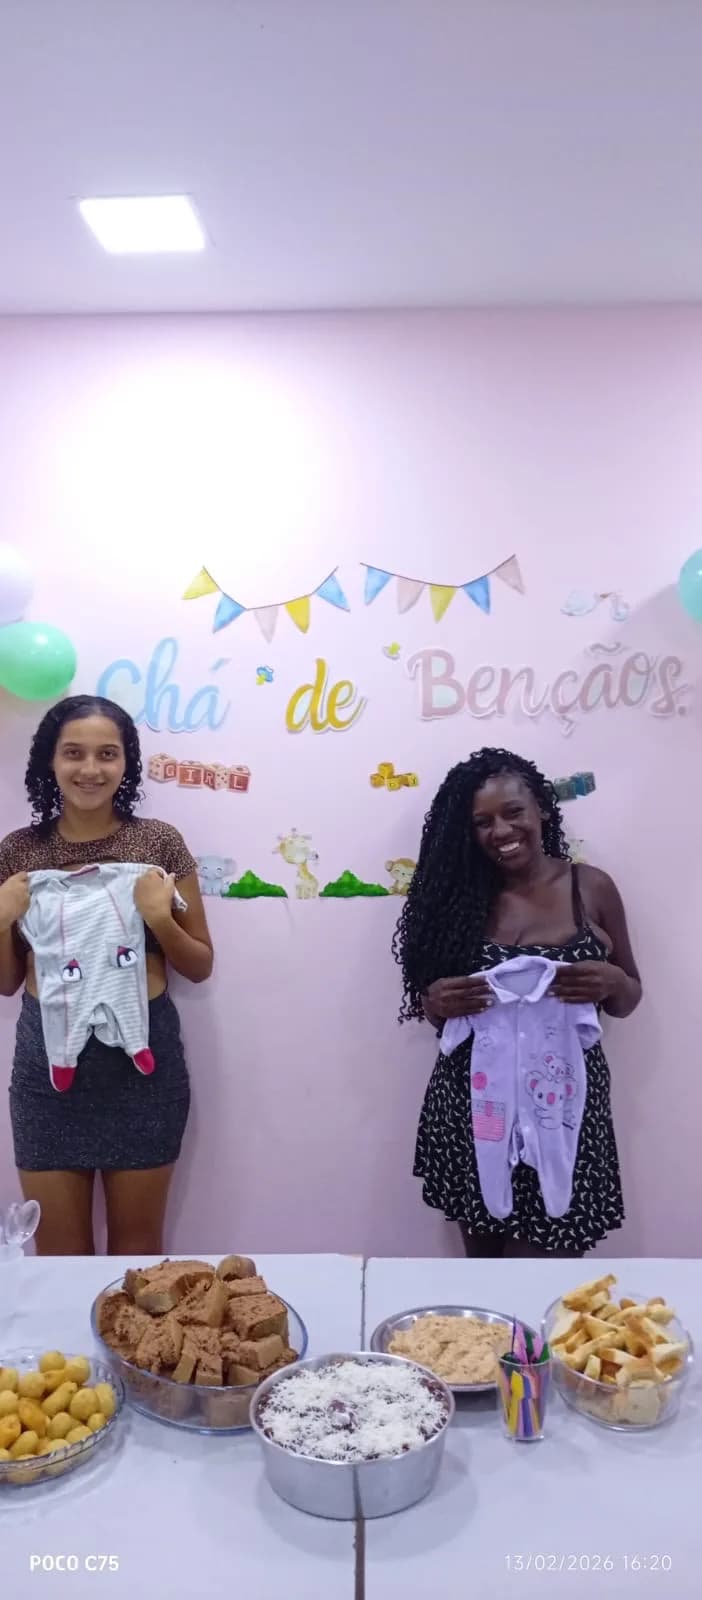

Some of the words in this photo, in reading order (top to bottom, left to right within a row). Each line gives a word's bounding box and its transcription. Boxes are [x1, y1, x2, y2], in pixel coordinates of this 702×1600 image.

[96, 637, 230, 732] Chá
[285, 658, 365, 733] de
[164, 763, 248, 791] GIRL
